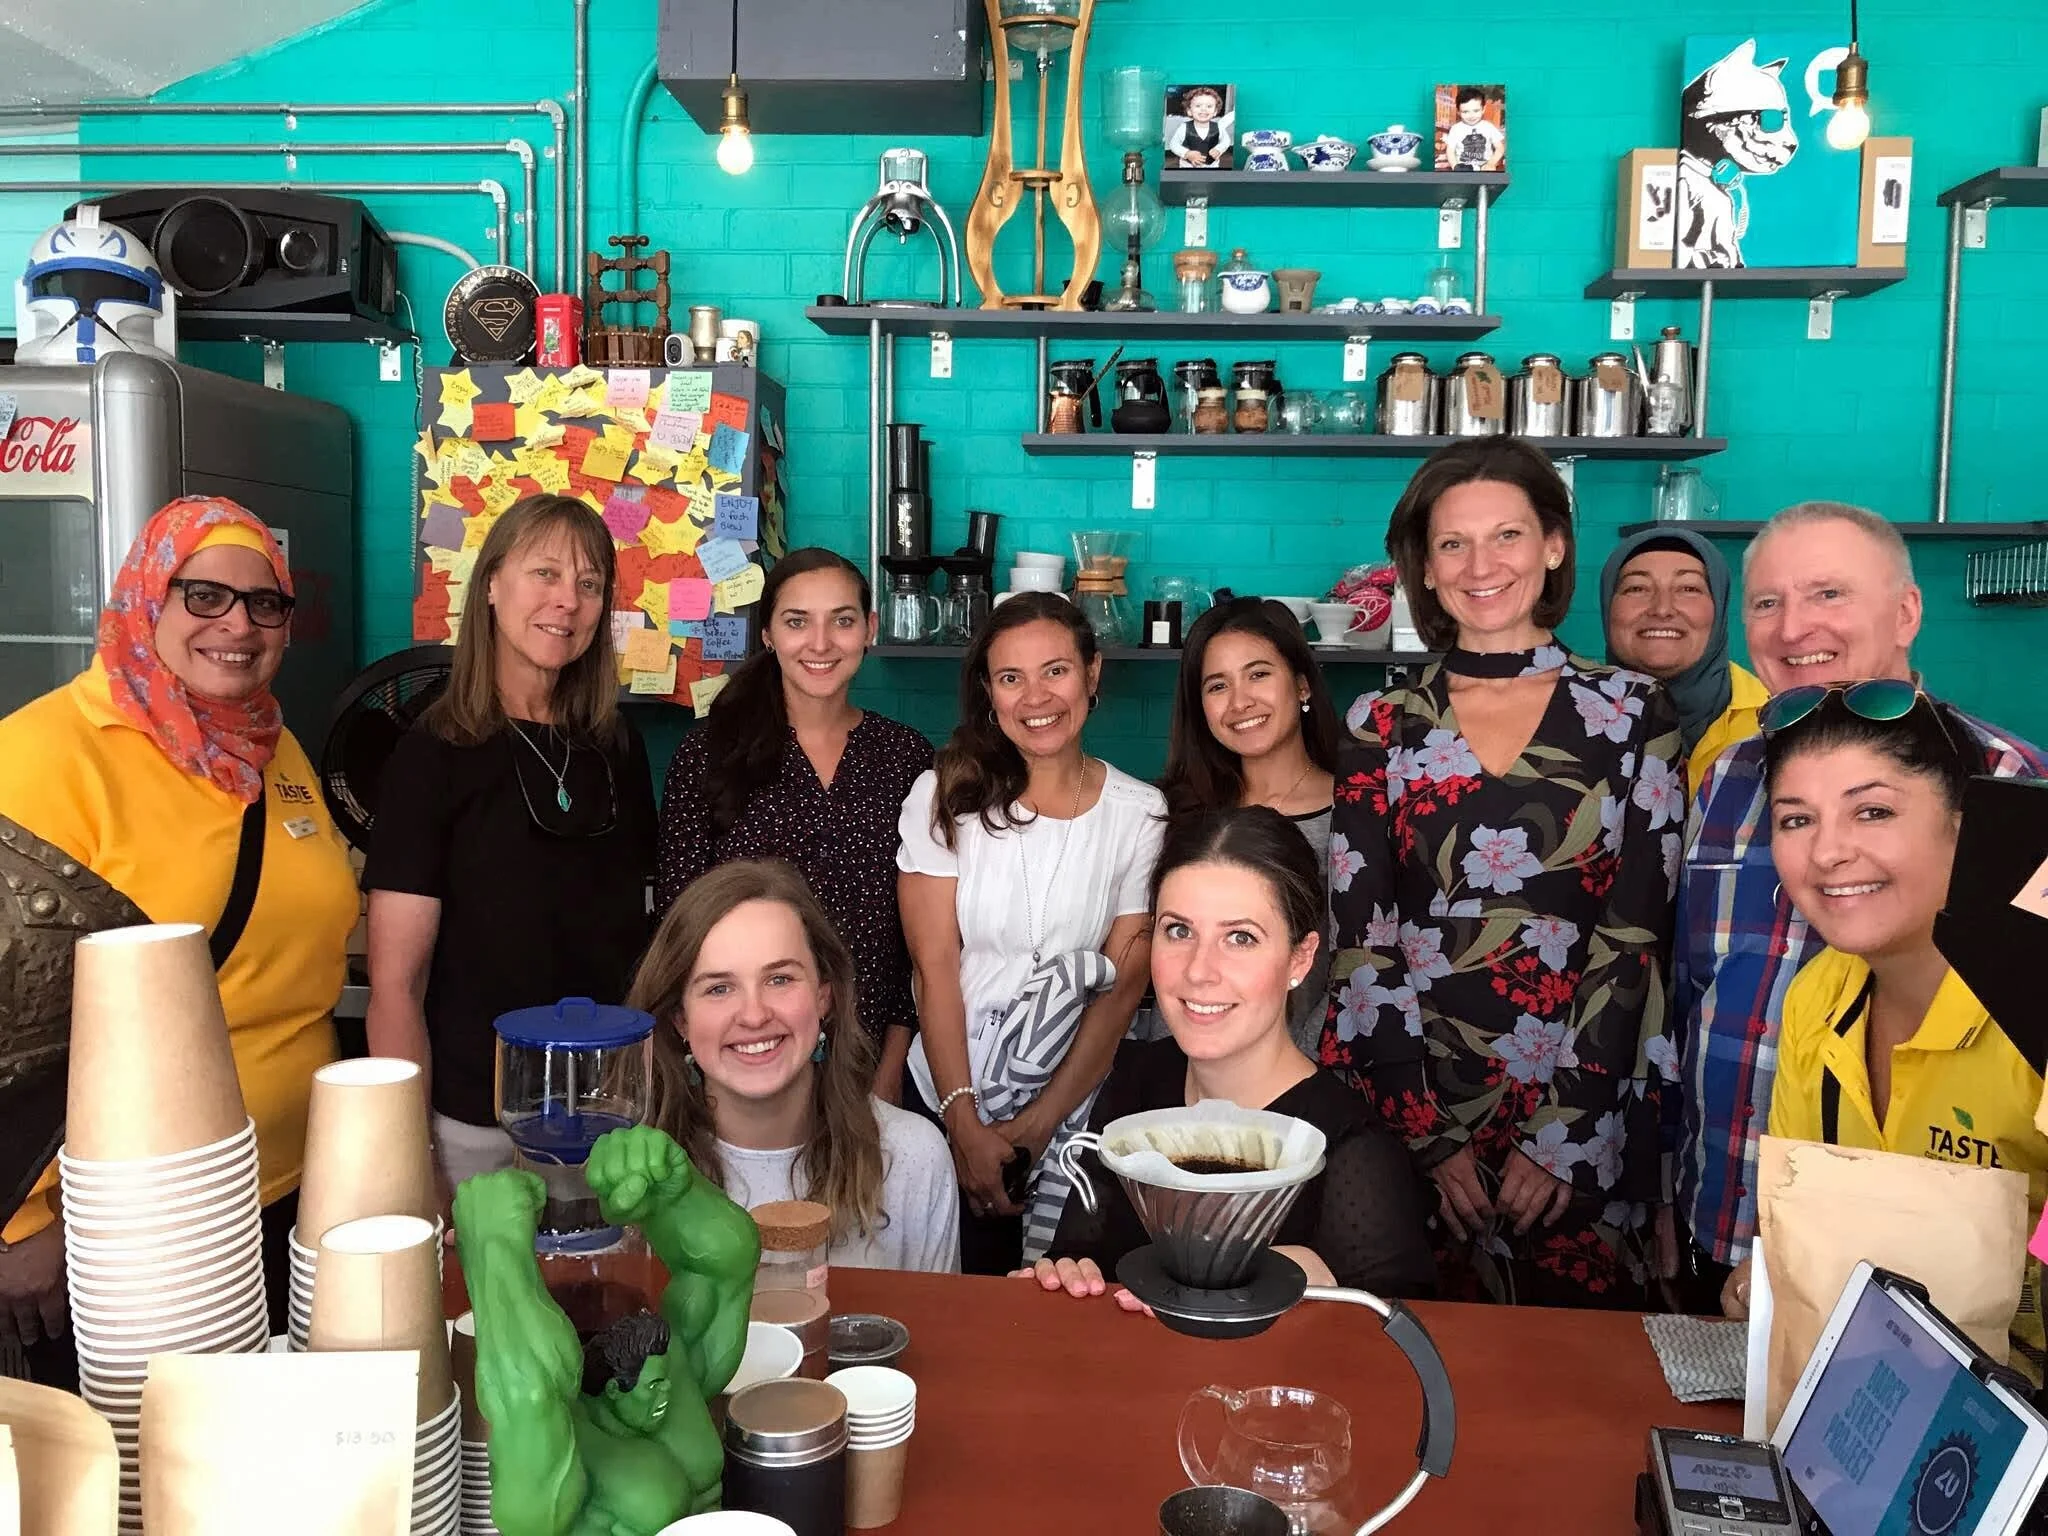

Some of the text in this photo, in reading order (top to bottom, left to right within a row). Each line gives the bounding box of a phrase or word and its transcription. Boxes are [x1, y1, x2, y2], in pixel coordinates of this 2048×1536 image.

[0, 416, 80, 473] Cola
[721, 496, 753, 511] ENJOY
[274, 783, 313, 800] TASTE
[1694, 1433, 1722, 1443] ANZ
